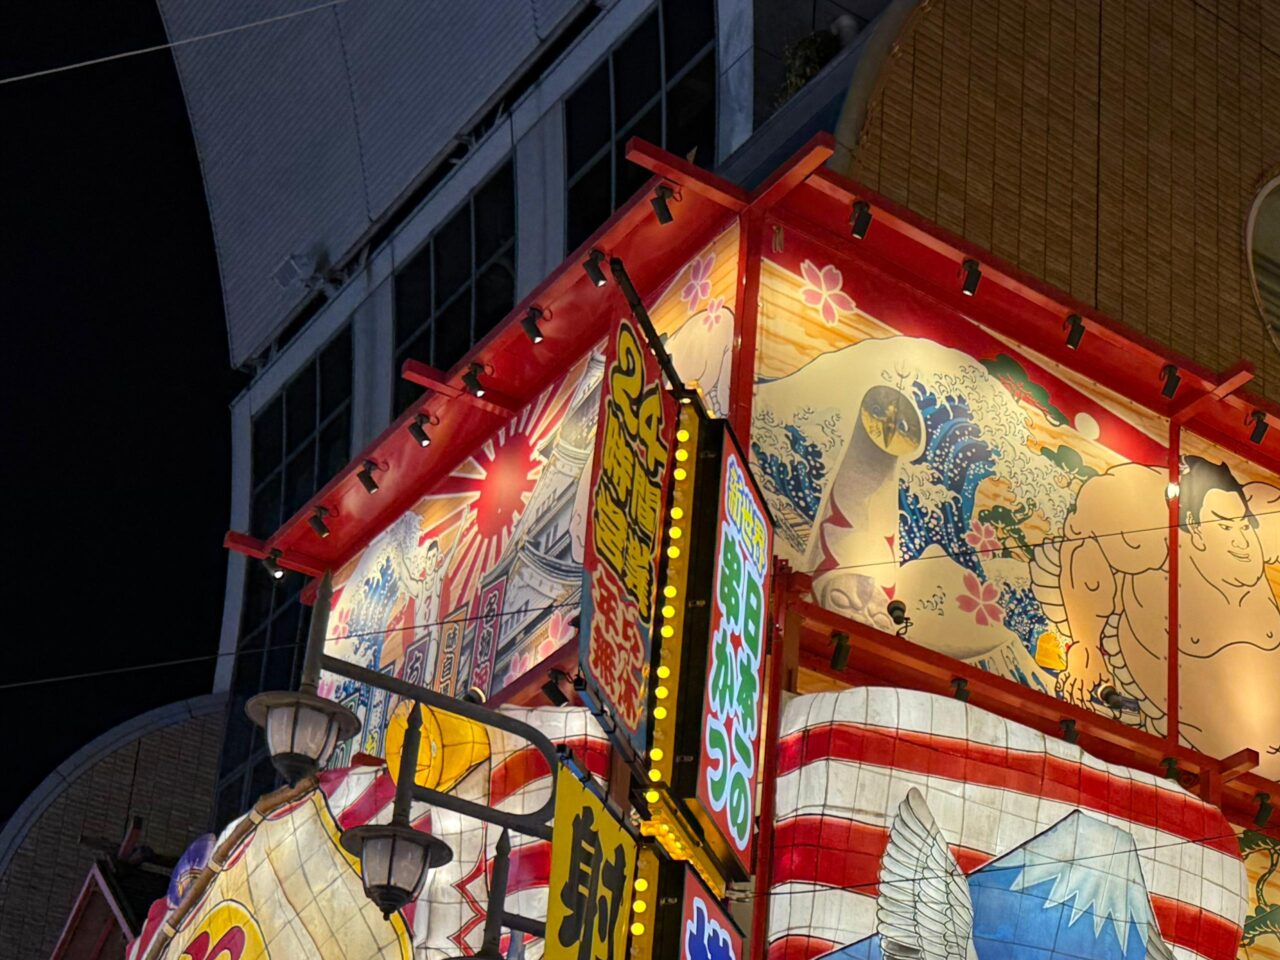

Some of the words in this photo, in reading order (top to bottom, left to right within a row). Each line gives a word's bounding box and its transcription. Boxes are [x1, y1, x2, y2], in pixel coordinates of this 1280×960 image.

[727, 456, 767, 576] 新世界
[706, 522, 741, 814] 串かつ
[727, 556, 764, 852] 日本一の
